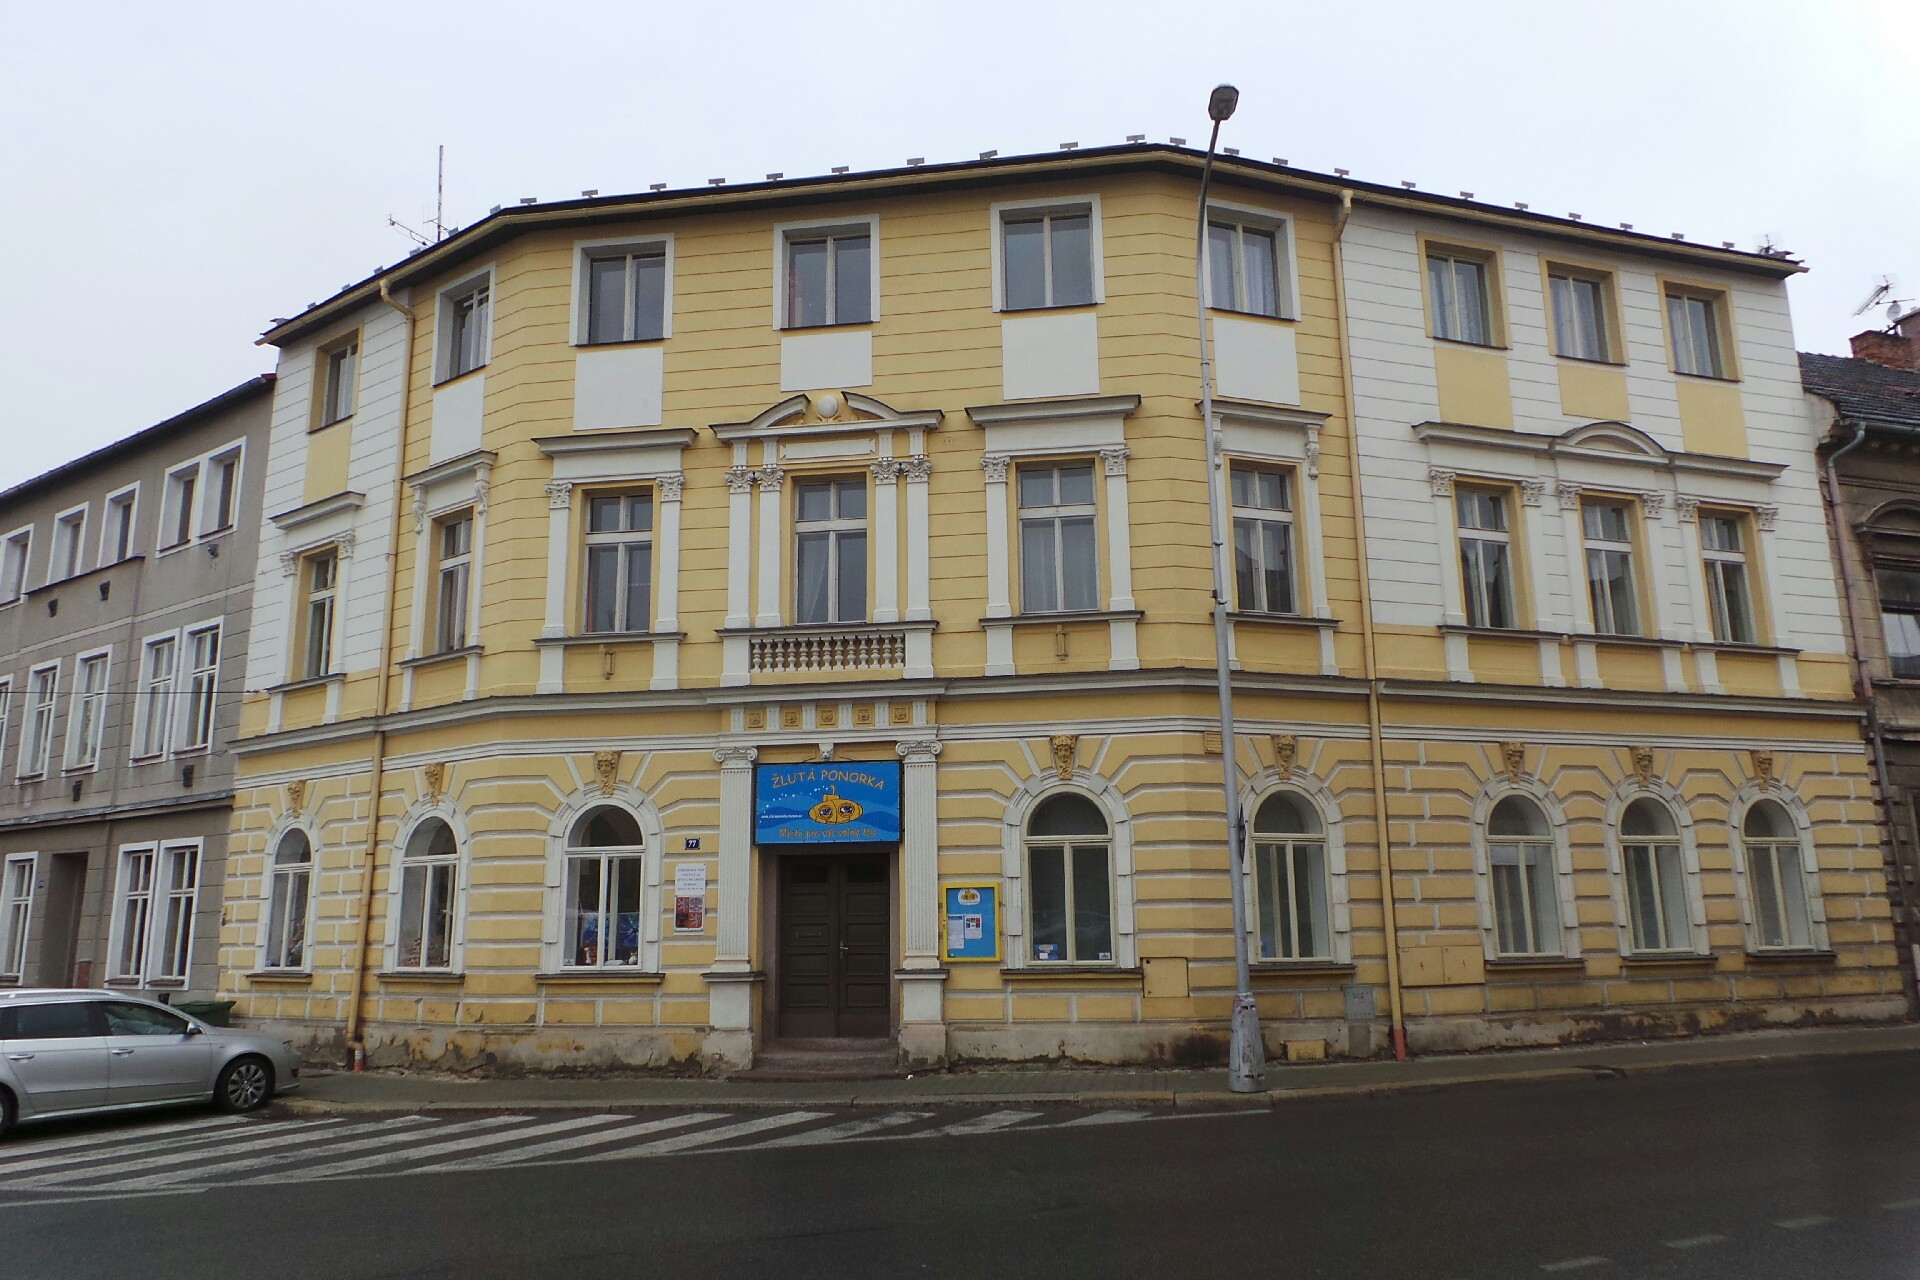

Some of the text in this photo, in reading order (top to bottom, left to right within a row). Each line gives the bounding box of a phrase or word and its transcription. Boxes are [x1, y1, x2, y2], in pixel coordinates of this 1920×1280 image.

[772, 768, 884, 789] ŽLUTÁ PONORKA
[688, 839, 697, 848] 77
